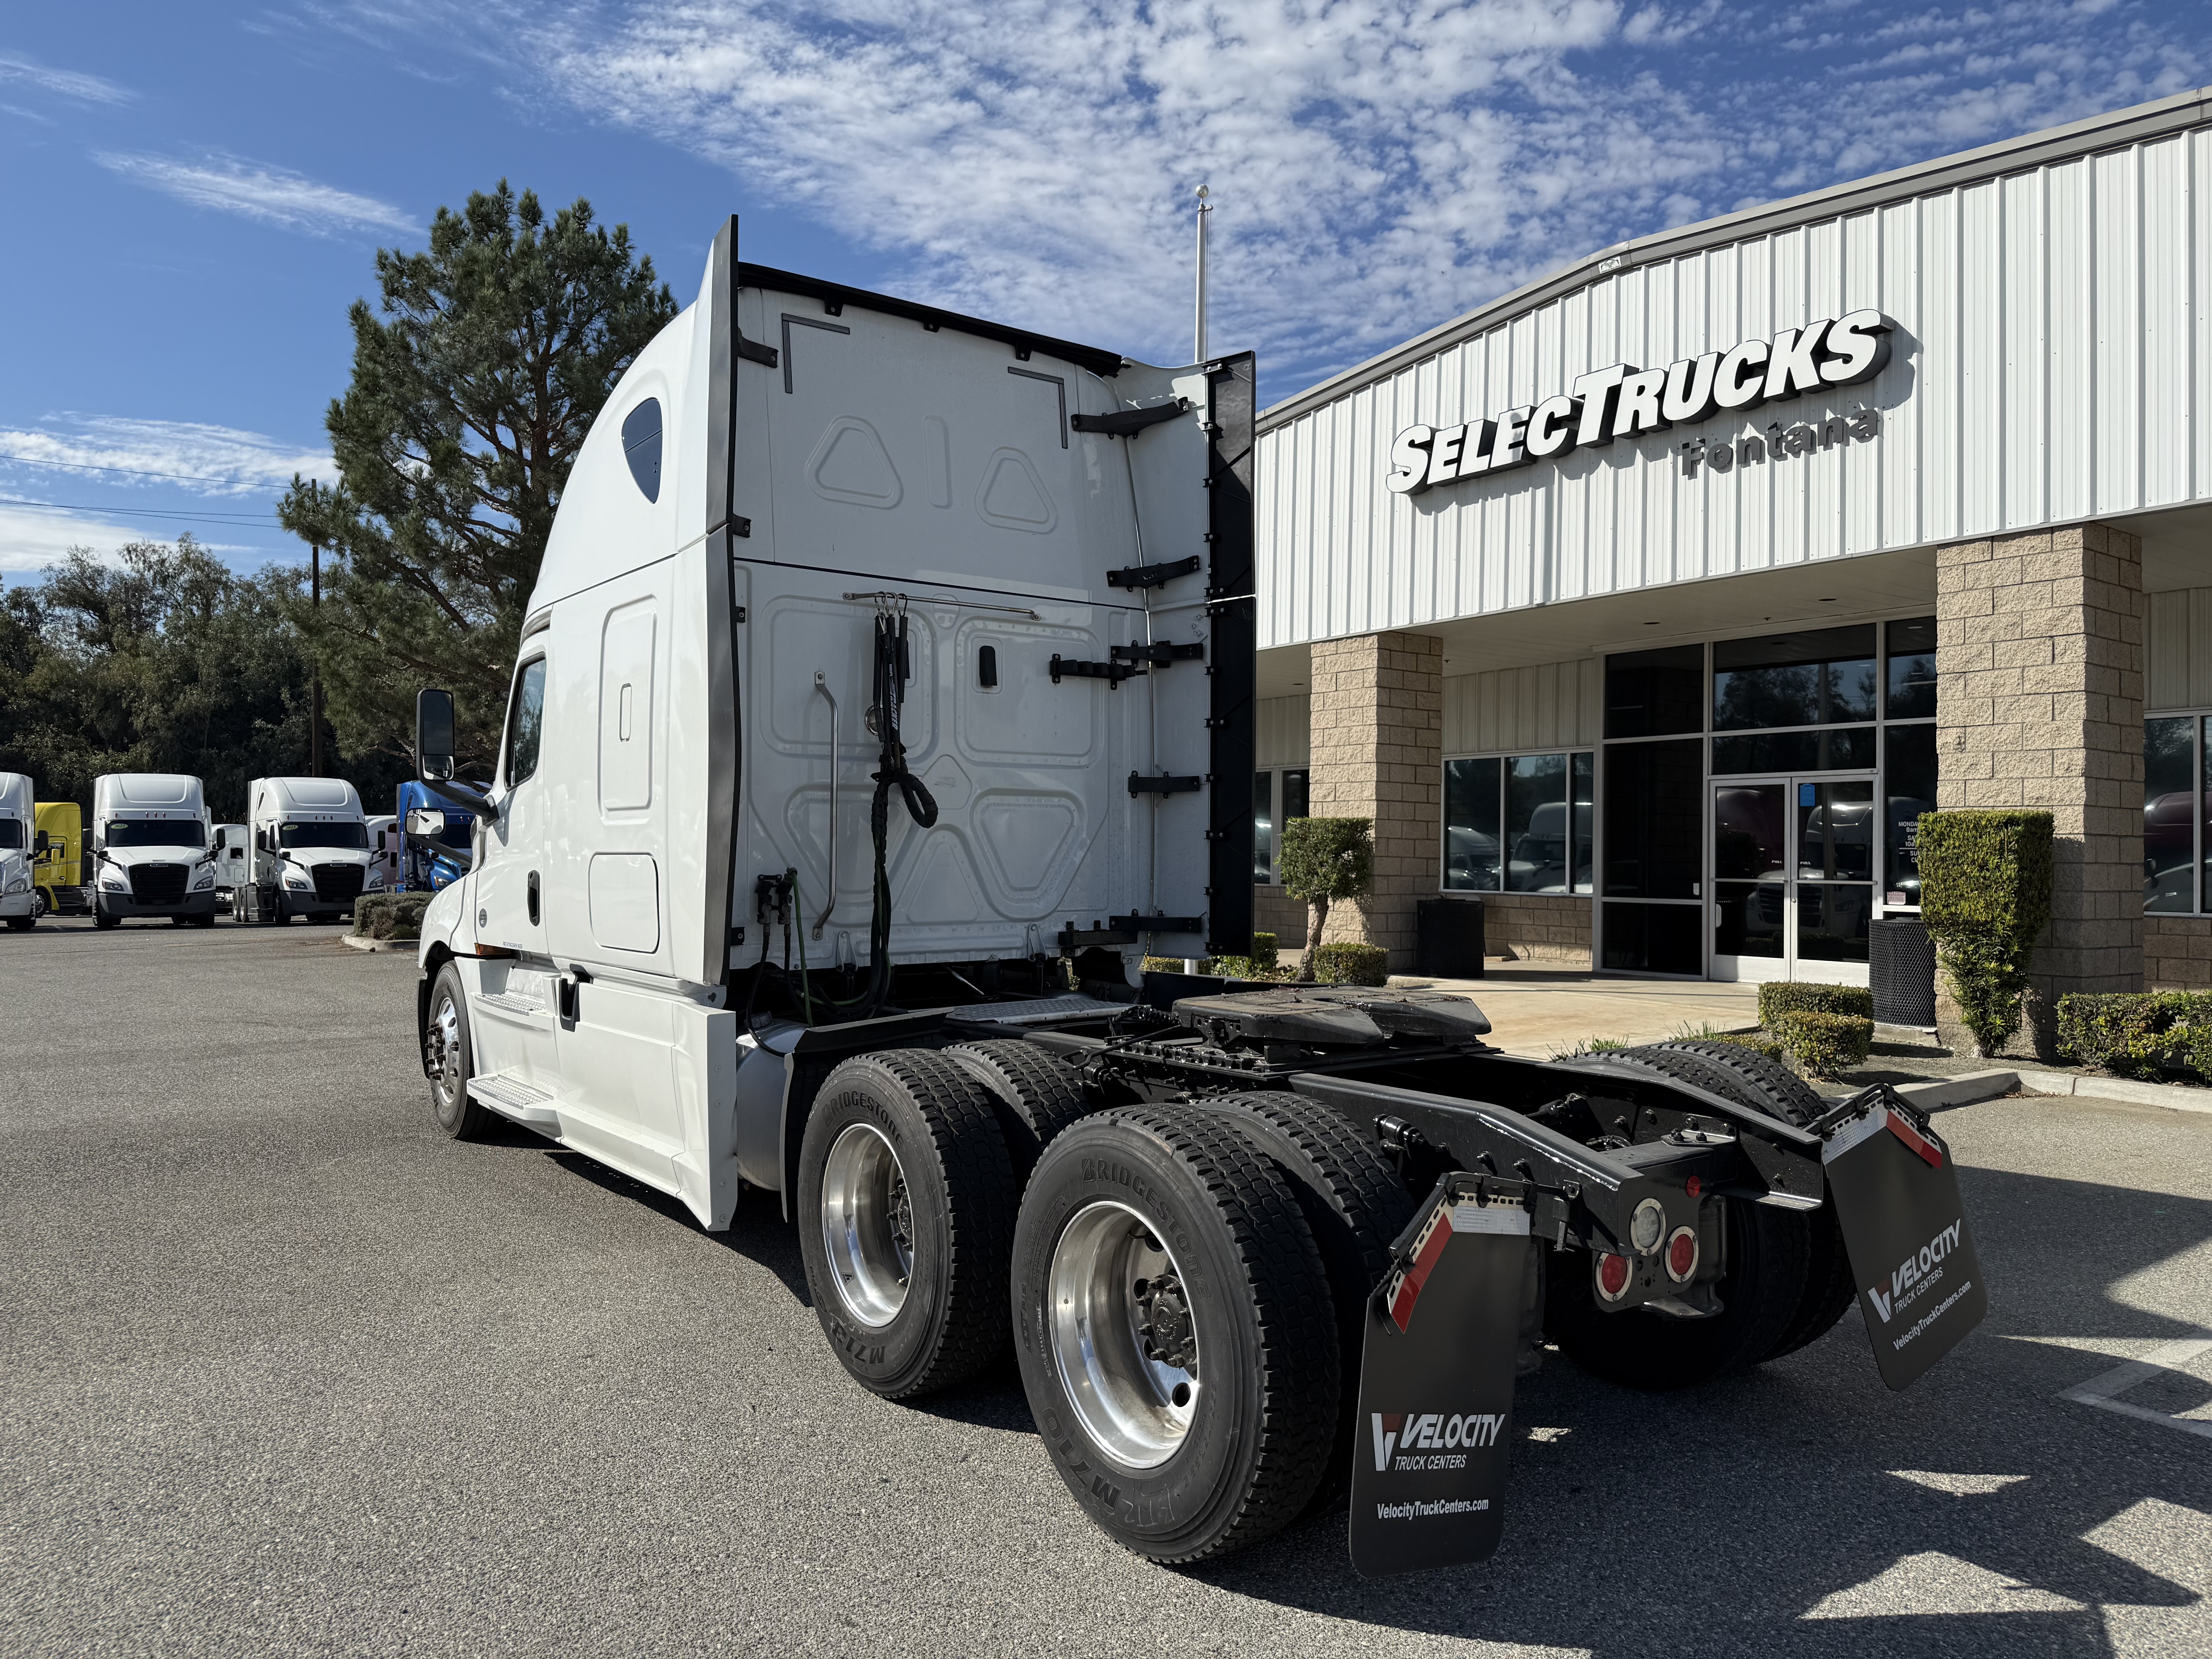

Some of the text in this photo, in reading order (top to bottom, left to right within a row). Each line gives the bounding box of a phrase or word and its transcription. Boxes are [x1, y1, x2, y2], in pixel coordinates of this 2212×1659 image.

[1386, 309, 1893, 495] SELECTRUCKS
[1682, 409, 1878, 476] Fontana
[822, 1091, 904, 1148] BRIDGESTONE
[1082, 1157, 1211, 1298] BRIDGESTONE
[1892, 1218, 1960, 1298] VELOCITY
[1893, 1280, 1972, 1350] VelocityTruckCenters.com
[1894, 1266, 1943, 1314] TRUCK CENTERS
[1042, 1407, 1121, 1510] M710
[1395, 1454, 1467, 1470] TRUCK CENTERS
[1400, 1413, 1506, 1448] VELOCITY
[1377, 1498, 1489, 1520] VelocityTruckCenters.com
